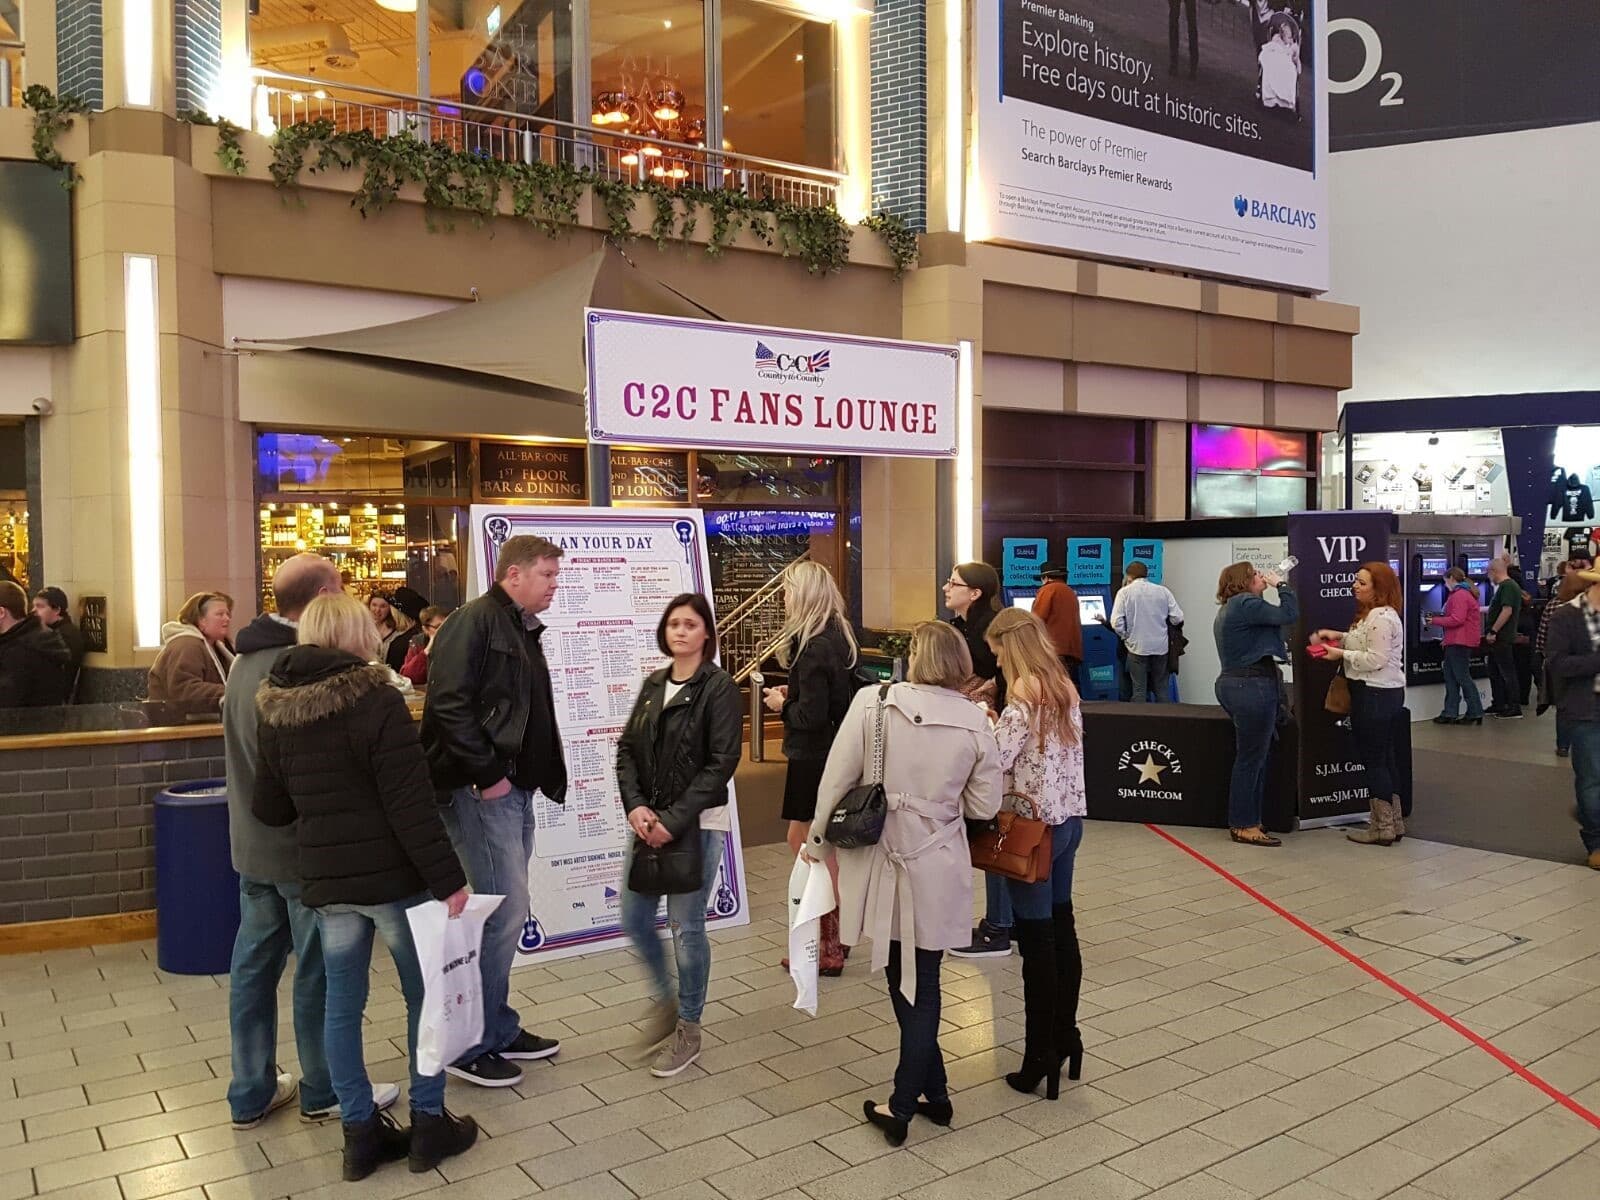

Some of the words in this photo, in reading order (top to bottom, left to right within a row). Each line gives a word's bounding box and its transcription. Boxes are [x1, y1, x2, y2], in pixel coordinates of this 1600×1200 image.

[1022, 0, 1056, 18] Premier
[1058, 9, 1094, 32] Banking
[1022, 21, 1088, 61] Explore
[1094, 41, 1154, 84] history.
[1022, 54, 1060, 86] Free
[1066, 67, 1106, 101] days
[1112, 85, 1140, 108] out
[1144, 93, 1160, 114] at
[1166, 92, 1220, 130] historic
[1226, 114, 1262, 140] sites.
[1022, 119, 1046, 140] The
[1050, 129, 1087, 148] power
[1090, 136, 1102, 152] of
[1104, 138, 1148, 162] Premier
[1022, 148, 1055, 166] Search
[1058, 156, 1096, 176] Barclays
[1099, 164, 1134, 182] Premier
[1136, 172, 1173, 192] Rewards
[1251, 199, 1316, 231] BARCLAYS
[758, 370, 787, 384] Country
[796, 374, 825, 388] Country
[624, 382, 697, 420] C2C
[710, 388, 803, 428] FANS
[814, 396, 937, 434] LOUNGE
[522, 469, 568, 481] FLOOR
[484, 482, 510, 494] BAR
[514, 484, 524, 494] &
[527, 483, 581, 495] DINING
[612, 485, 624, 496] IP
[628, 486, 680, 497] LOUNGE
[582, 536, 622, 549] YOUR
[626, 536, 652, 549] DAY
[1316, 536, 1366, 564] VIP
[1010, 564, 1030, 572] Tickets
[1320, 574, 1334, 584] UP
[1320, 588, 1353, 598] CHECK
[1118, 751, 1132, 770] VIP
[1131, 740, 1176, 760] CHECK
[1170, 760, 1183, 774] IN
[1315, 763, 1342, 777] S.J.M.
[1118, 788, 1183, 801] SJM-VIP.COM
